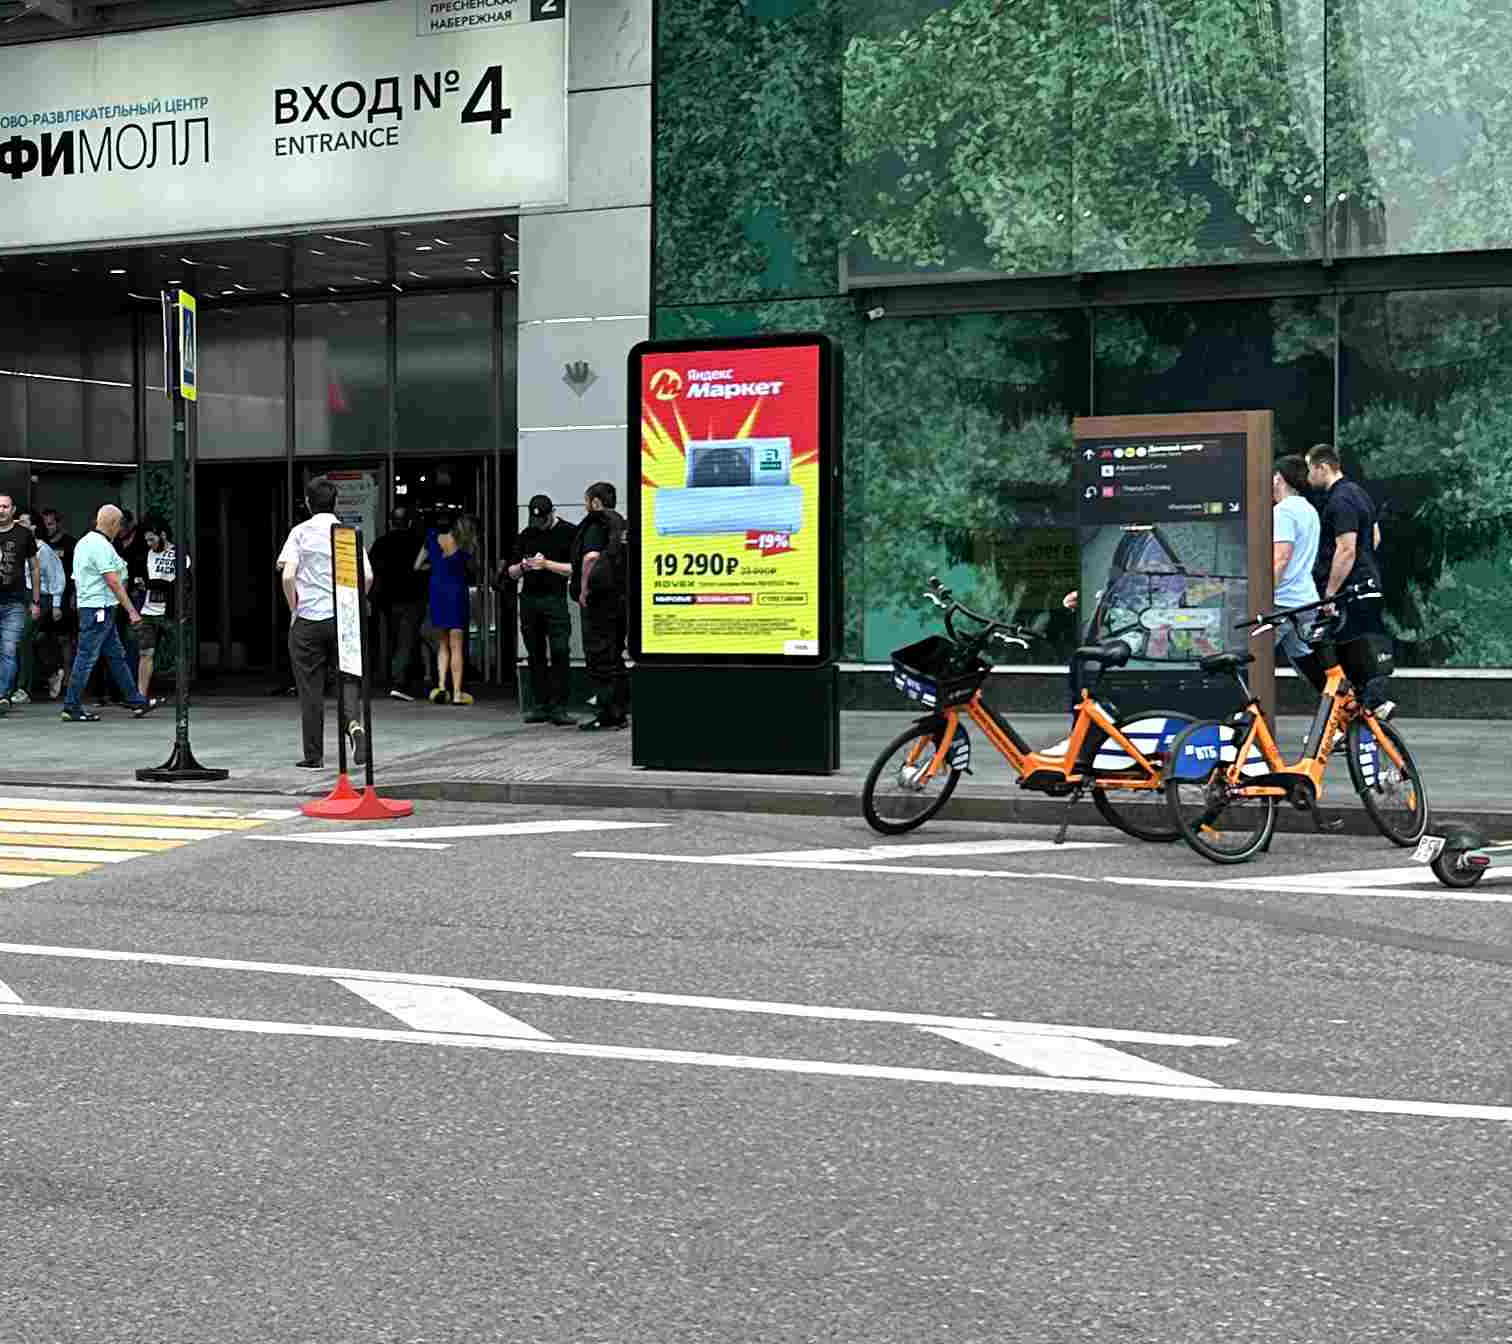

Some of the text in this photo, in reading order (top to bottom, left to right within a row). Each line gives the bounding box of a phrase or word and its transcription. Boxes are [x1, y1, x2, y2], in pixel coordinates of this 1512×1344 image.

[430, 10, 513, 30] НАБЕРЕЖНАЯ
[164, 96, 209, 114] ЦЕНТР
[275, 76, 403, 124] ВХОД
[274, 126, 400, 156] ENTRANCE
[687, 368, 734, 381] Яндекс
[686, 380, 784, 399] Маркет
